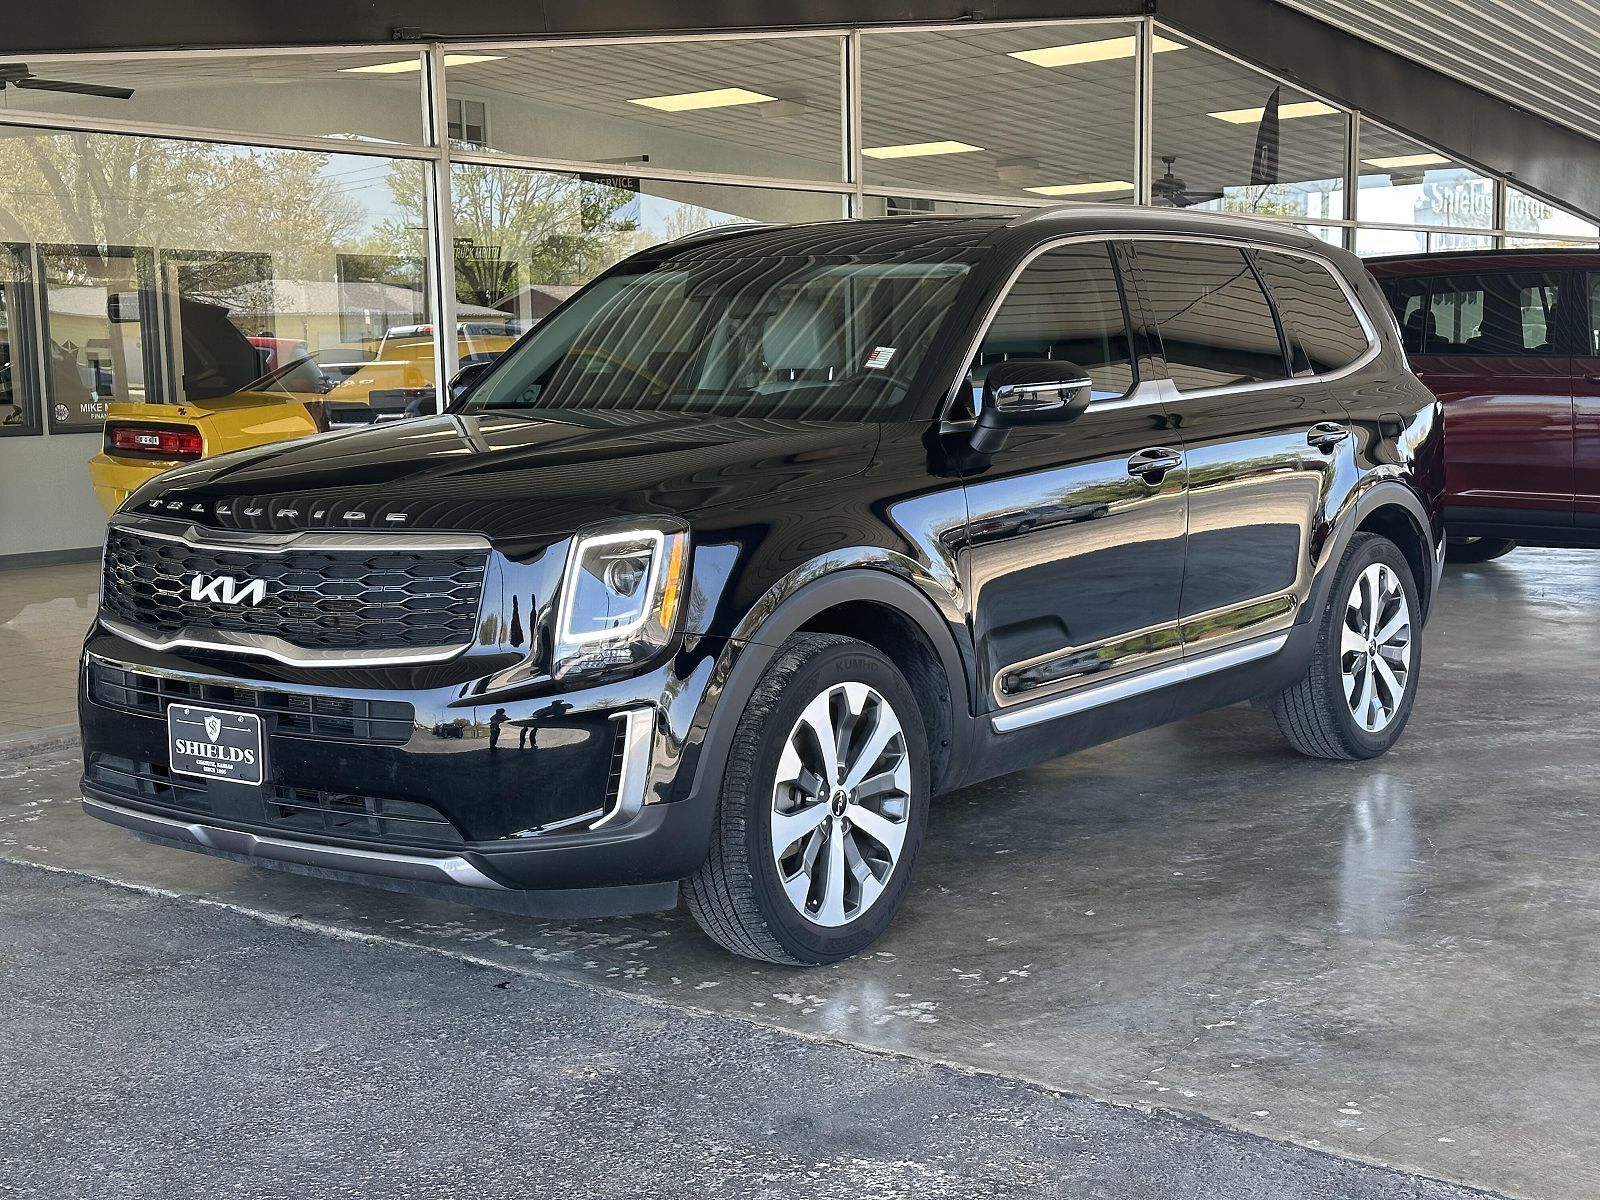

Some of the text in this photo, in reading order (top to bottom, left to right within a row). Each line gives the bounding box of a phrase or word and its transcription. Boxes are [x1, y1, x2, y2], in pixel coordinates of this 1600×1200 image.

[80, 403, 103, 413] MIKE
[149, 499, 408, 522] TELLURIDE
[190, 573, 267, 606] KIA
[175, 739, 255, 765] SHIELDS
